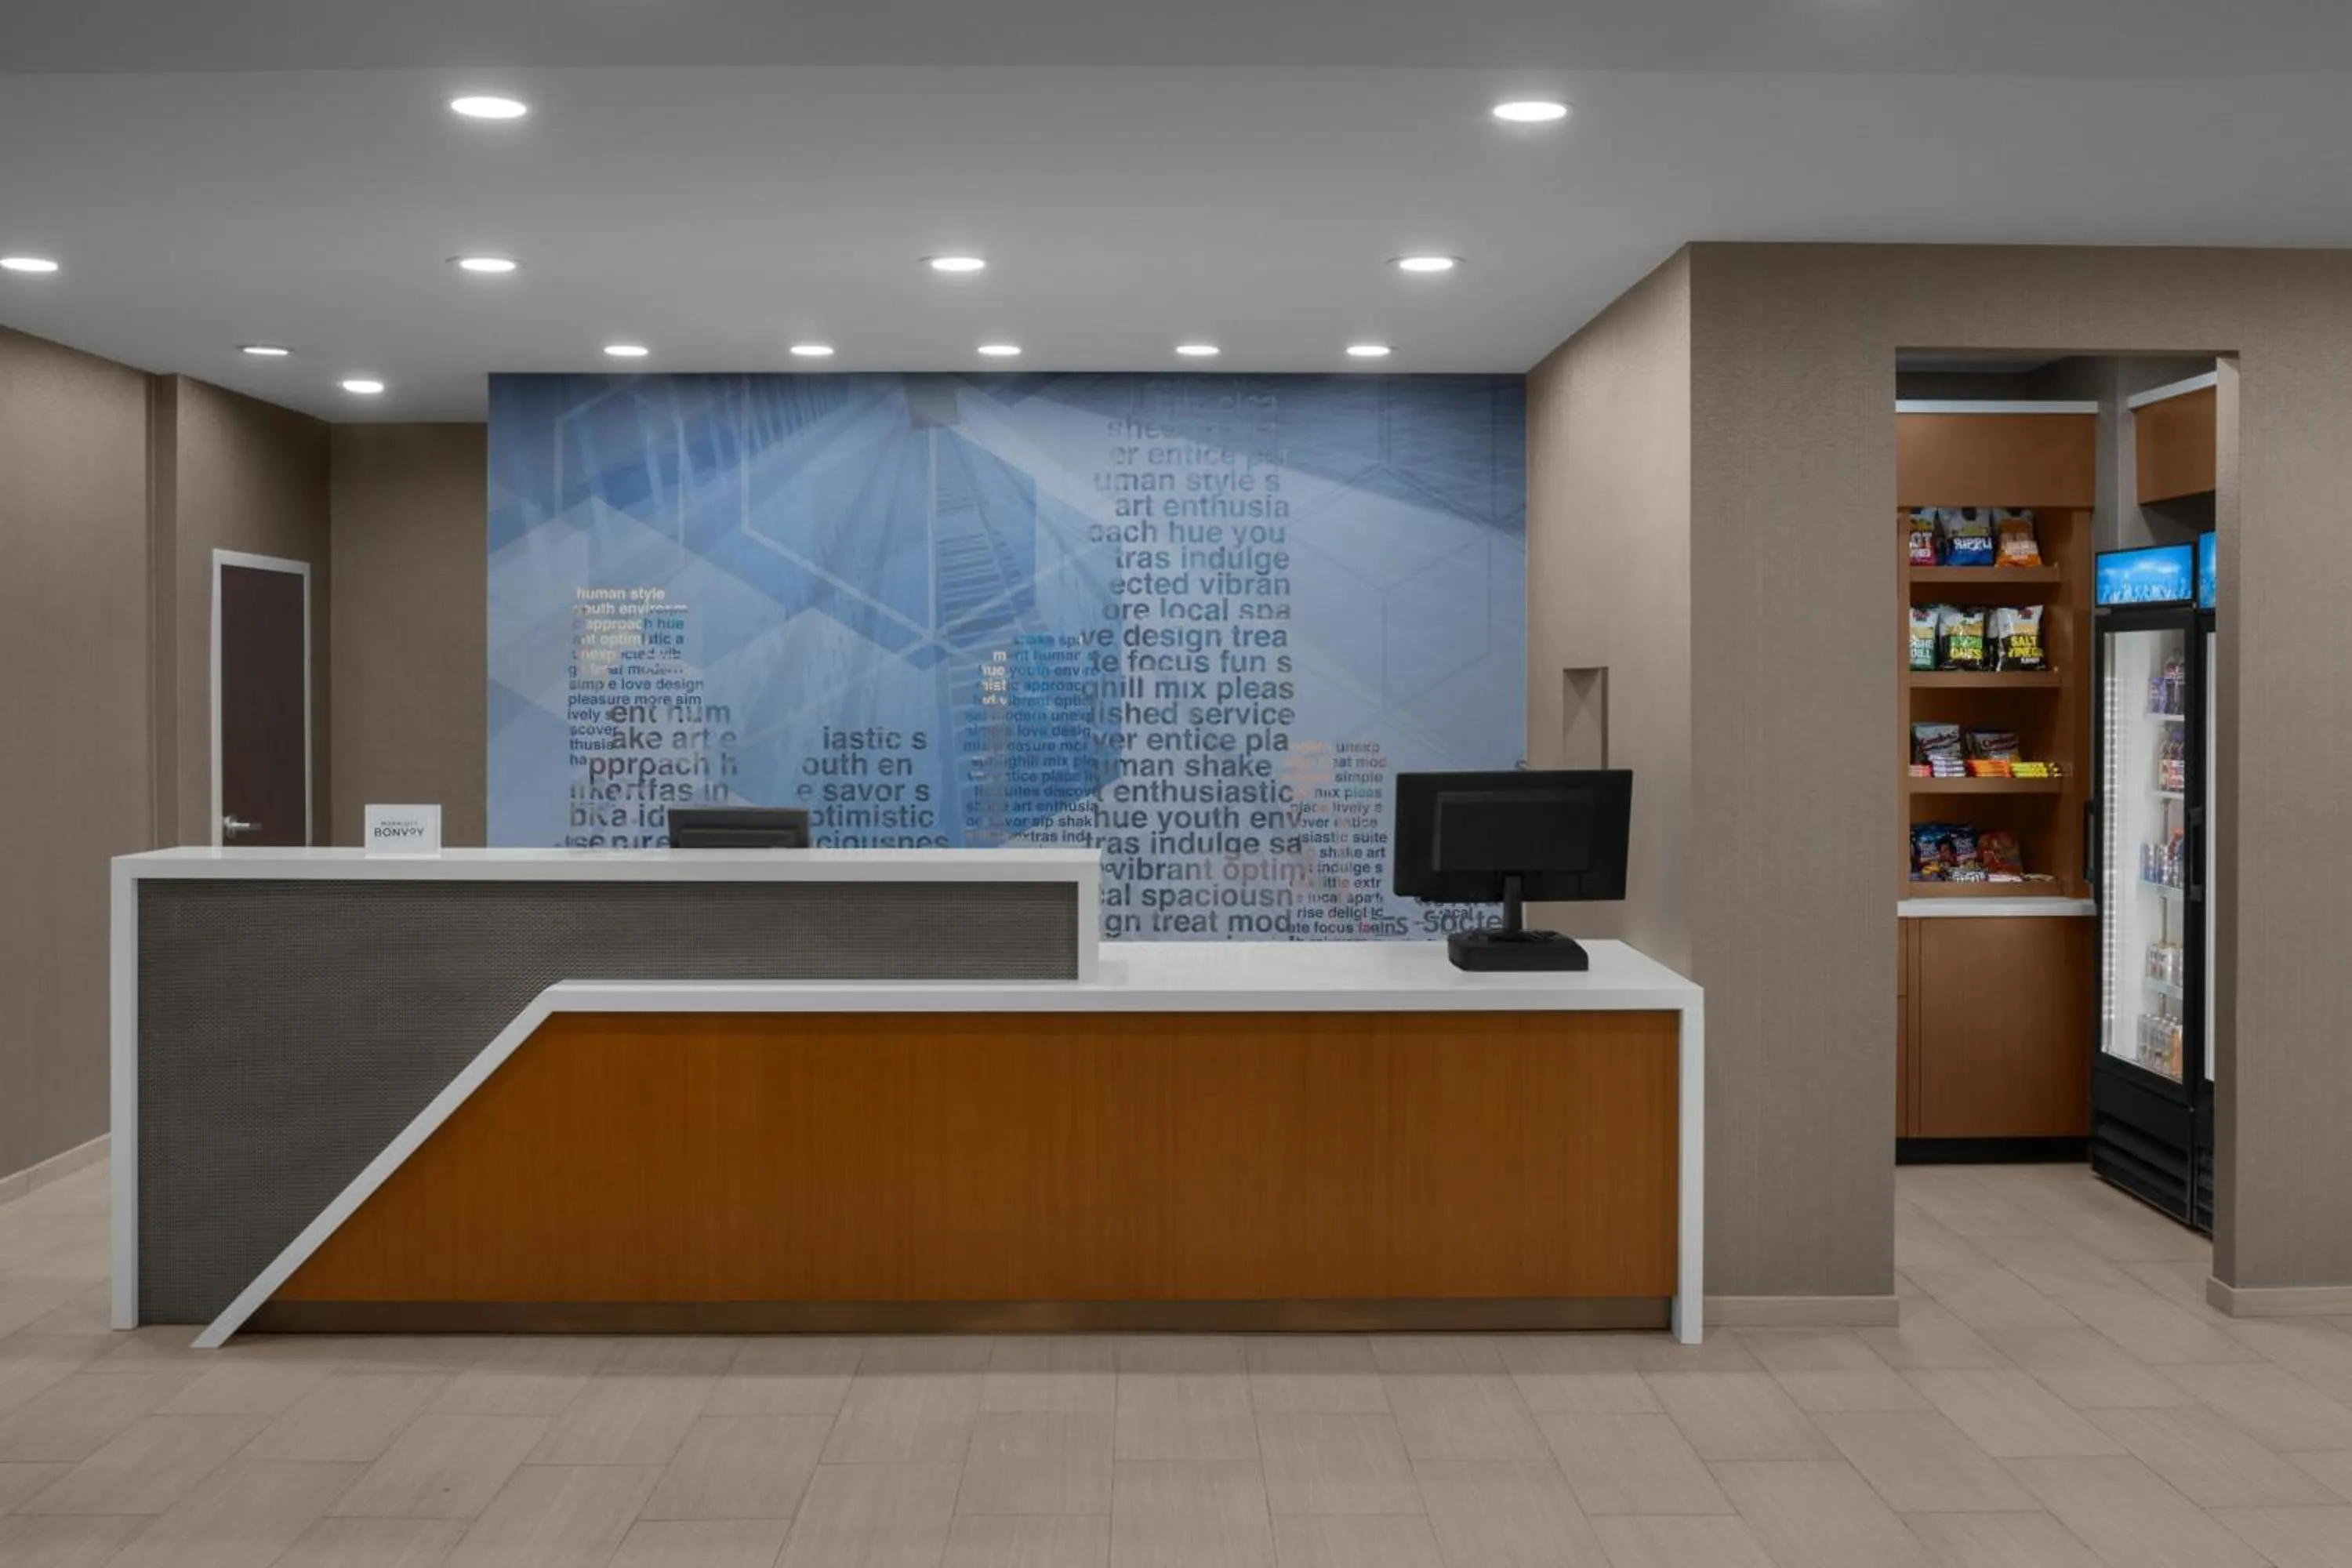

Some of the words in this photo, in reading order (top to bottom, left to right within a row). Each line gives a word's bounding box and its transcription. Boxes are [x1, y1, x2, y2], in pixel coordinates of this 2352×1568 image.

[1186, 470, 1255, 497] style
[1265, 473, 1281, 492] s
[1115, 495, 1152, 517] art
[1163, 494, 1290, 517] enthusia
[1088, 518, 1157, 543] oach
[1169, 521, 1223, 543] hue
[1232, 524, 1287, 550] you
[1181, 546, 1290, 575] indulge
[1109, 572, 1189, 595] ected
[1200, 572, 1291, 596] vibran
[1102, 602, 1150, 620] ore
[1160, 597, 1229, 621] local
[1123, 625, 1222, 653] design
[1232, 626, 1288, 648] trea
[1127, 649, 1210, 673] focus
[1220, 649, 1266, 673] fun
[1277, 654, 1294, 673] s
[1155, 680, 1207, 699] mix
[1217, 676, 1295, 705] pleas
[1189, 702, 1296, 725] service
[823, 726, 902, 750] iastic
[912, 731, 928, 750] s
[1147, 728, 1236, 751] entice
[1247, 728, 1290, 755] pla
[878, 757, 913, 775] en
[1185, 753, 1273, 777] shake
[823, 783, 906, 802] savor
[915, 783, 931, 802] s
[1114, 780, 1294, 803] enthusiastic
[1094, 803, 1149, 828] hue
[1158, 807, 1240, 834] youth
[374, 827, 424, 838] BONVOY
[1151, 831, 1261, 860] indulge
[1269, 835, 1302, 855] sa
[1112, 857, 1214, 880] vibrant
[1141, 884, 1294, 912] spaciousn
[1152, 910, 1218, 933] treat
